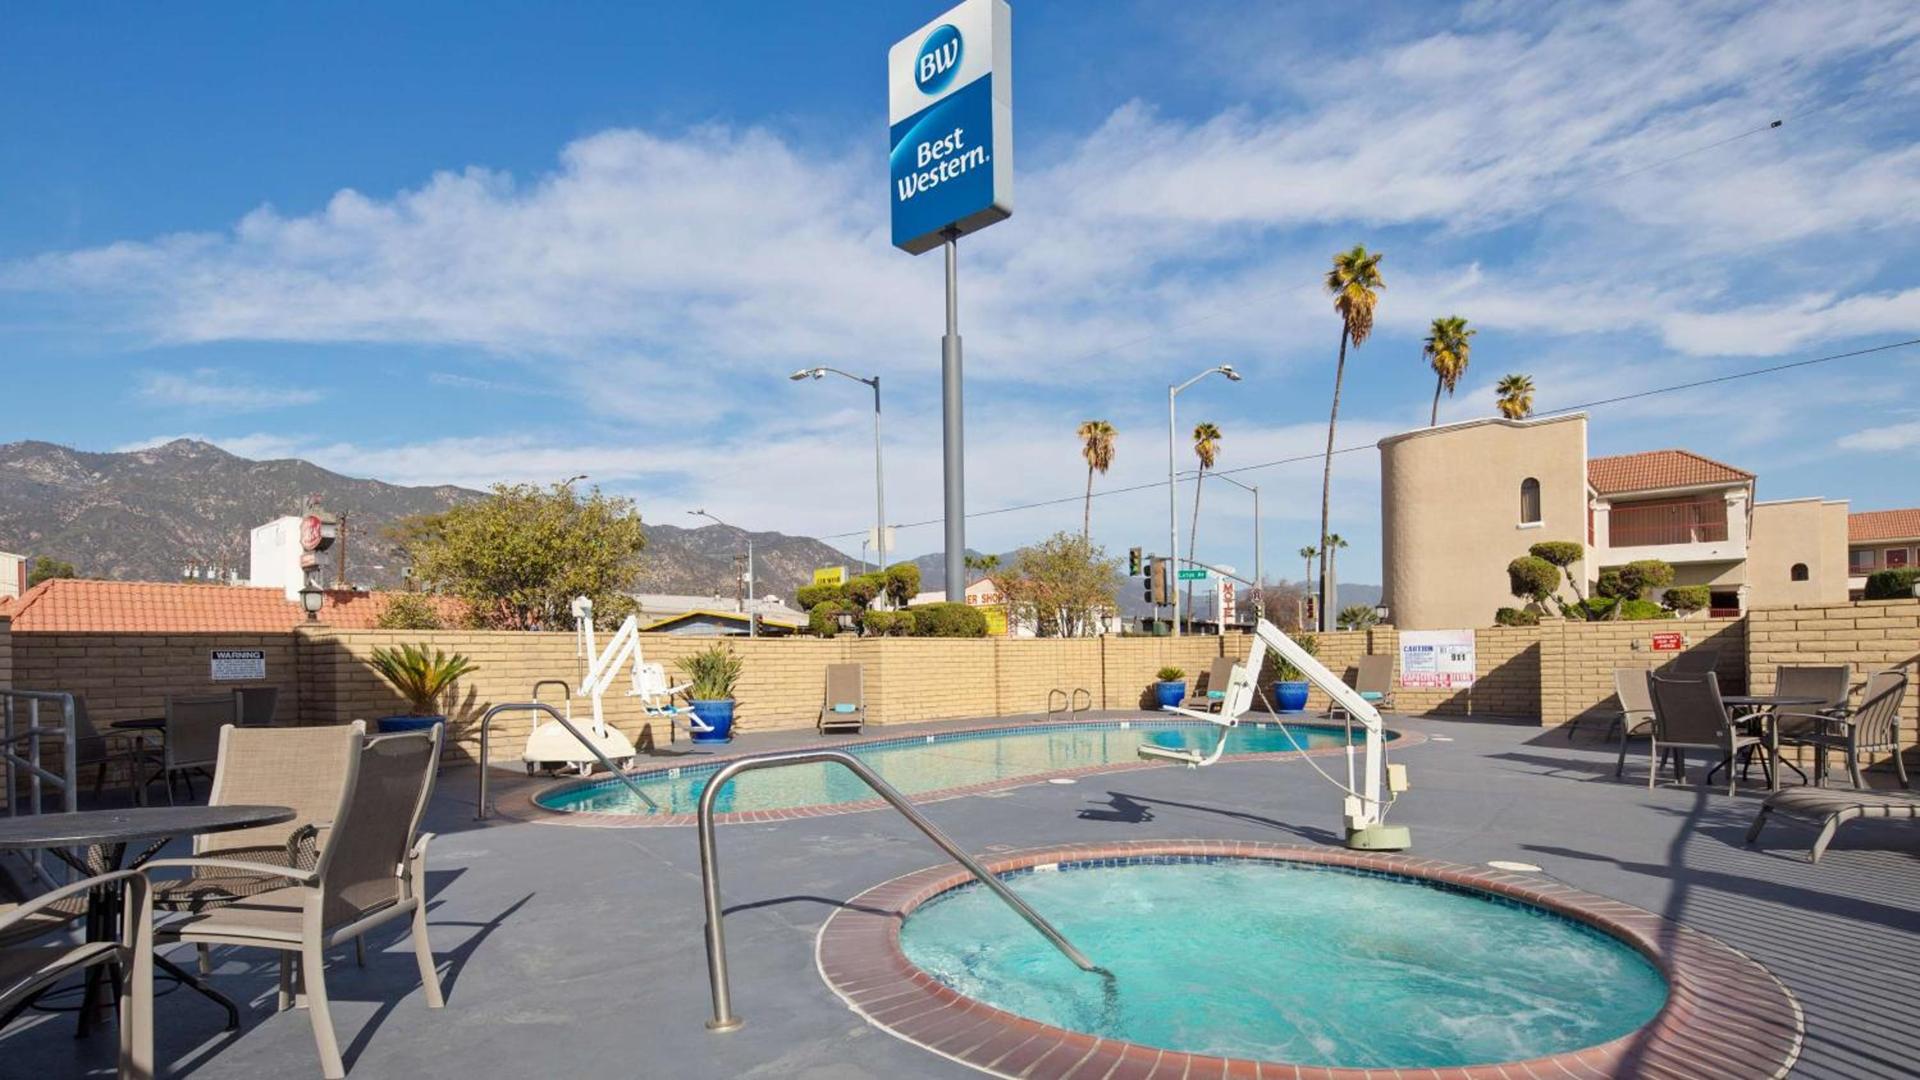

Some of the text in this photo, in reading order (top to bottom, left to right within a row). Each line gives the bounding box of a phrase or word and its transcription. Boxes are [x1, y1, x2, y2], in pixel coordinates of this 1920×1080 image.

[920, 38, 958, 83] BW
[917, 127, 964, 168] Best
[981, 592, 1004, 603] SHOP
[1403, 645, 1433, 653] CAUTION
[216, 651, 261, 659] WARNING
[1451, 653, 1466, 661] 911
